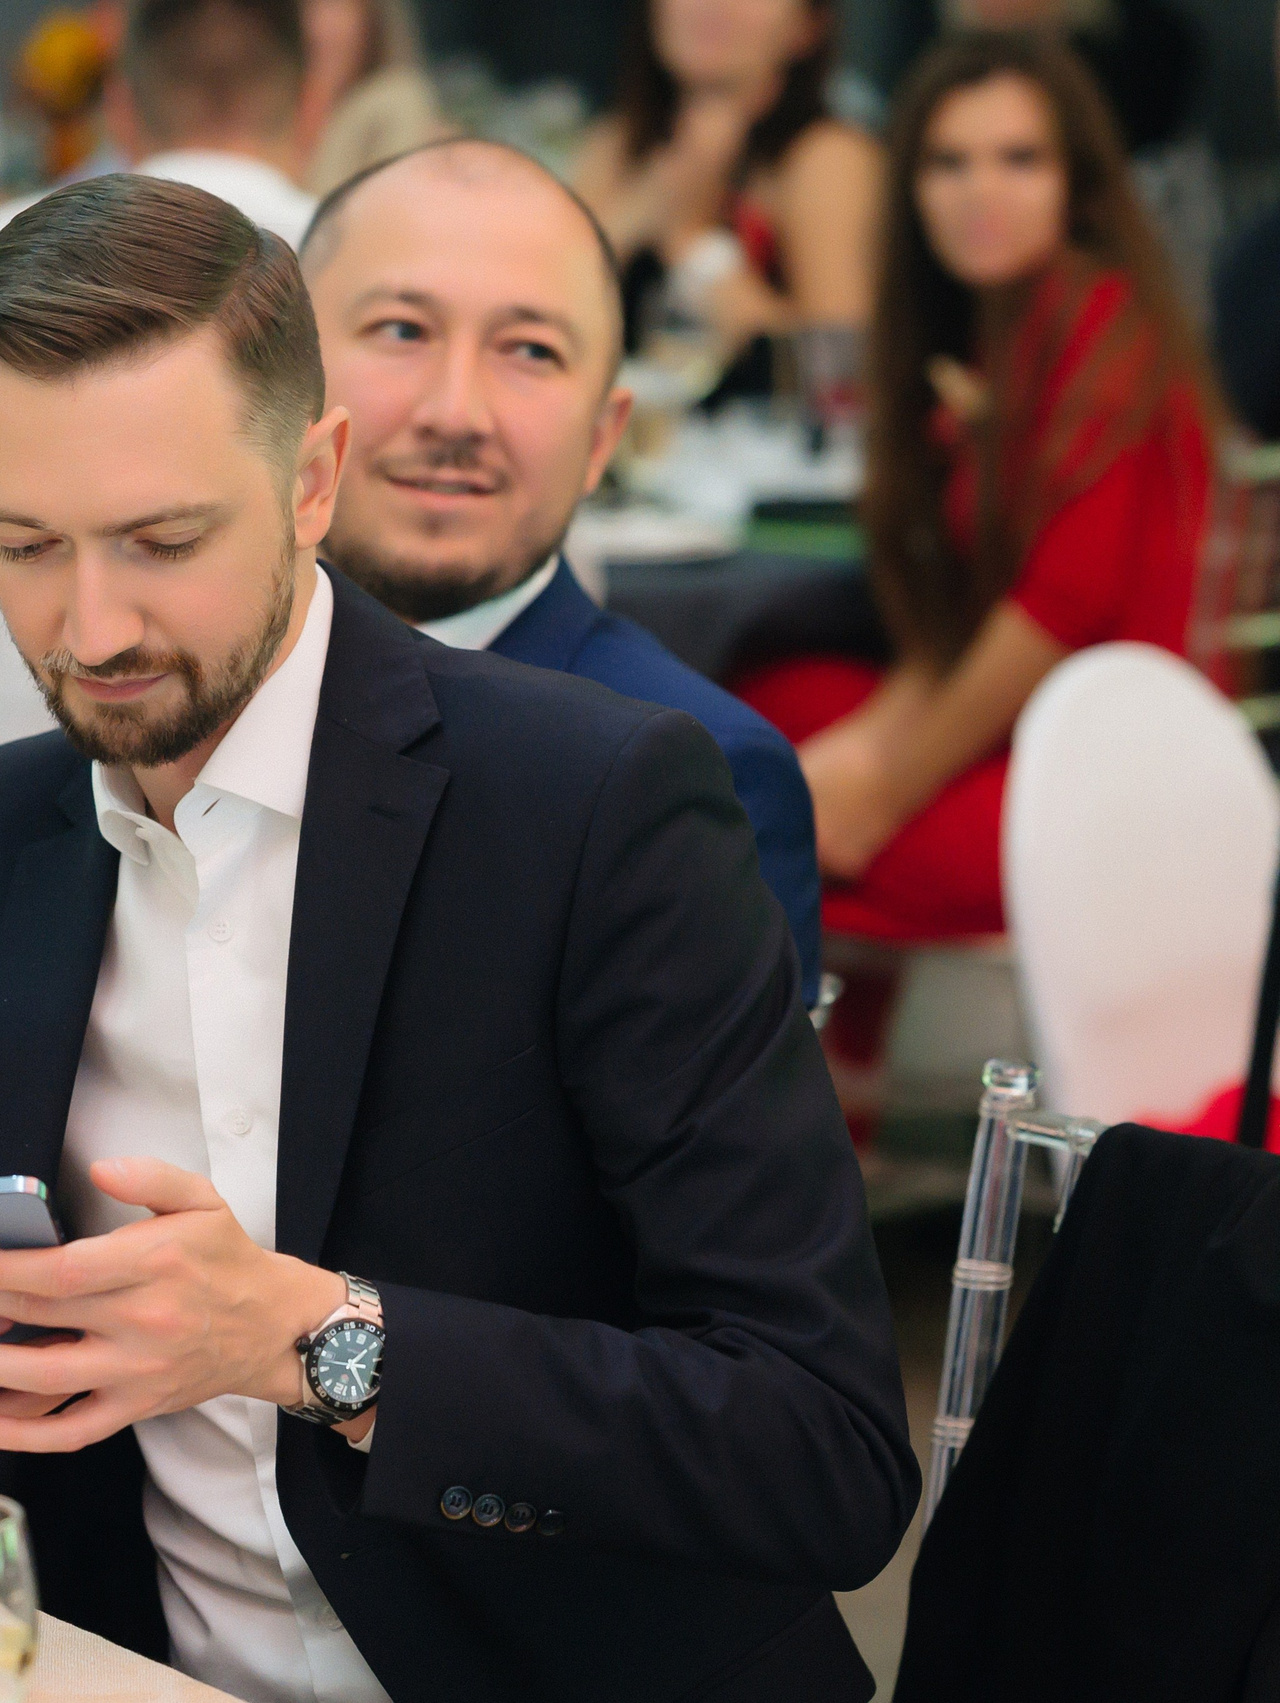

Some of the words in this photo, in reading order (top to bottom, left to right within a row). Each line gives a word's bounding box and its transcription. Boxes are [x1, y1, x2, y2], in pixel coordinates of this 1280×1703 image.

[324, 1328, 336, 1340] 20
[364, 1323, 376, 1333] 30
[333, 1382, 348, 1396] 12
